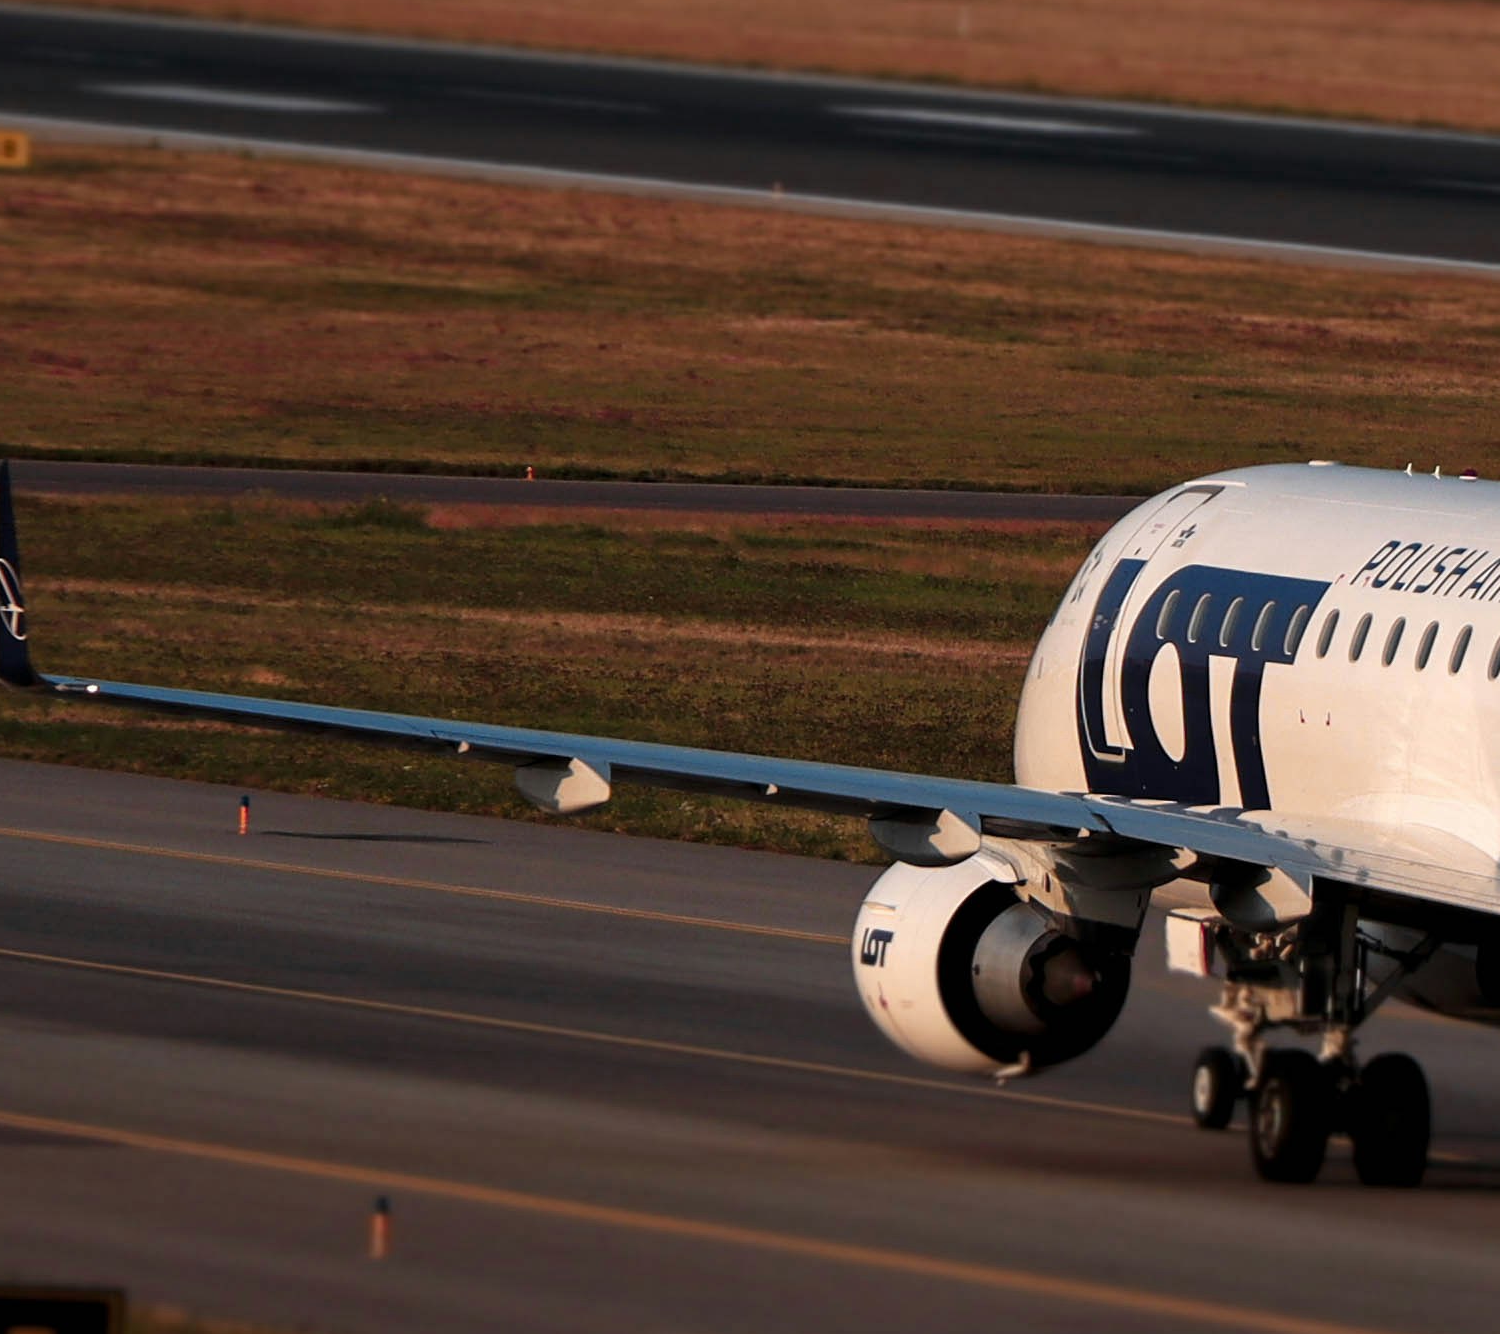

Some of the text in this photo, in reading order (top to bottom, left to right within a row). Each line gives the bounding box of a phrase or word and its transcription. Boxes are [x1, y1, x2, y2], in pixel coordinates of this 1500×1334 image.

[1349, 540, 1489, 597] POLISH
[1076, 557, 1333, 811] LOT
[860, 927, 894, 968] LOT
